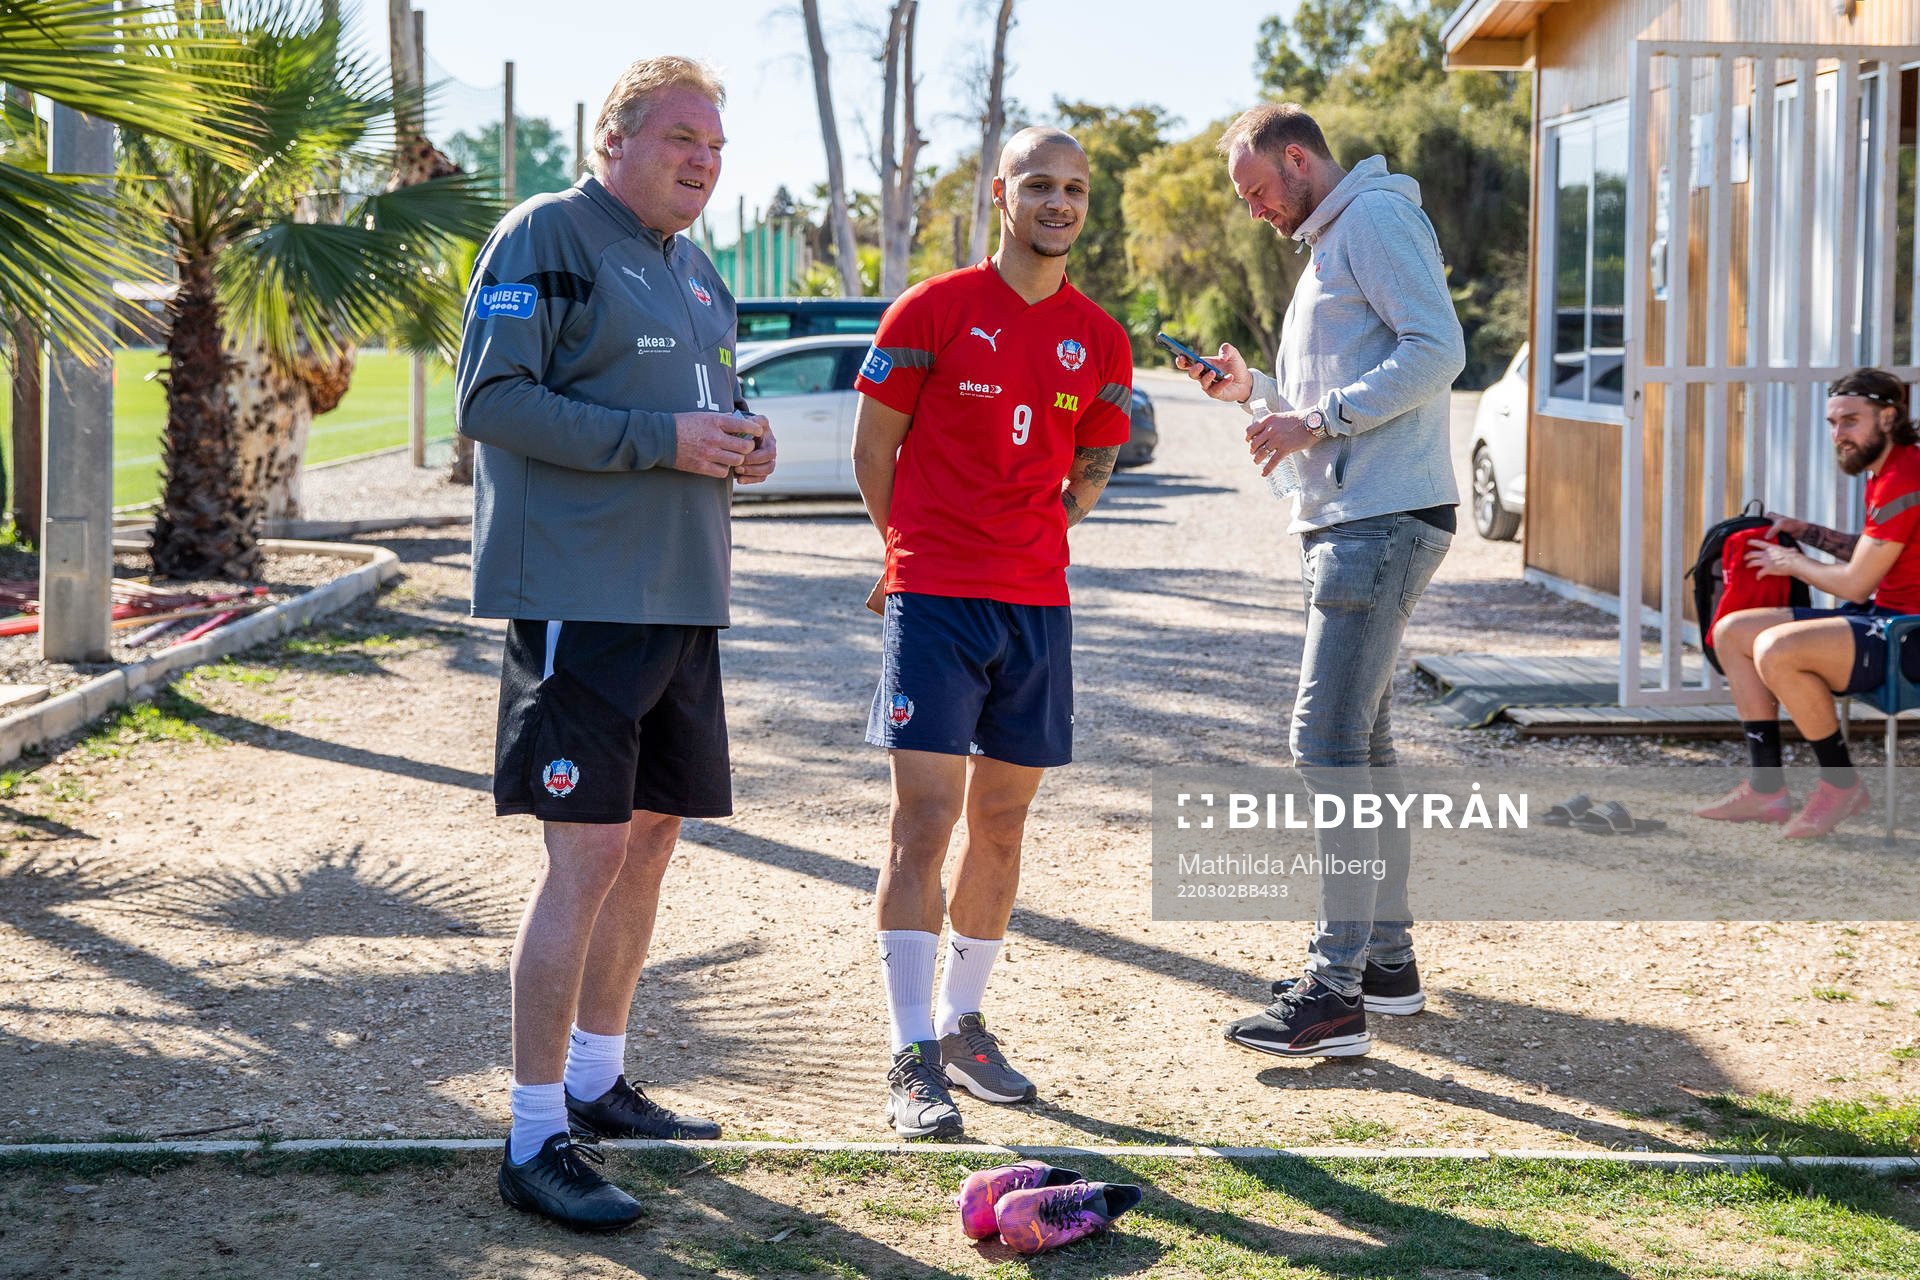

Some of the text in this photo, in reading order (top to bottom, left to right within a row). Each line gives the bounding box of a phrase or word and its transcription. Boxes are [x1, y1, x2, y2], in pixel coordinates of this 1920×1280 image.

[482, 290, 533, 307] UNIBET
[636, 334, 665, 348] akea
[719, 347, 732, 369] XXL
[694, 363, 719, 412] JL
[958, 380, 989, 393] akea
[1053, 392, 1078, 412] XXL
[1012, 404, 1033, 446] 9
